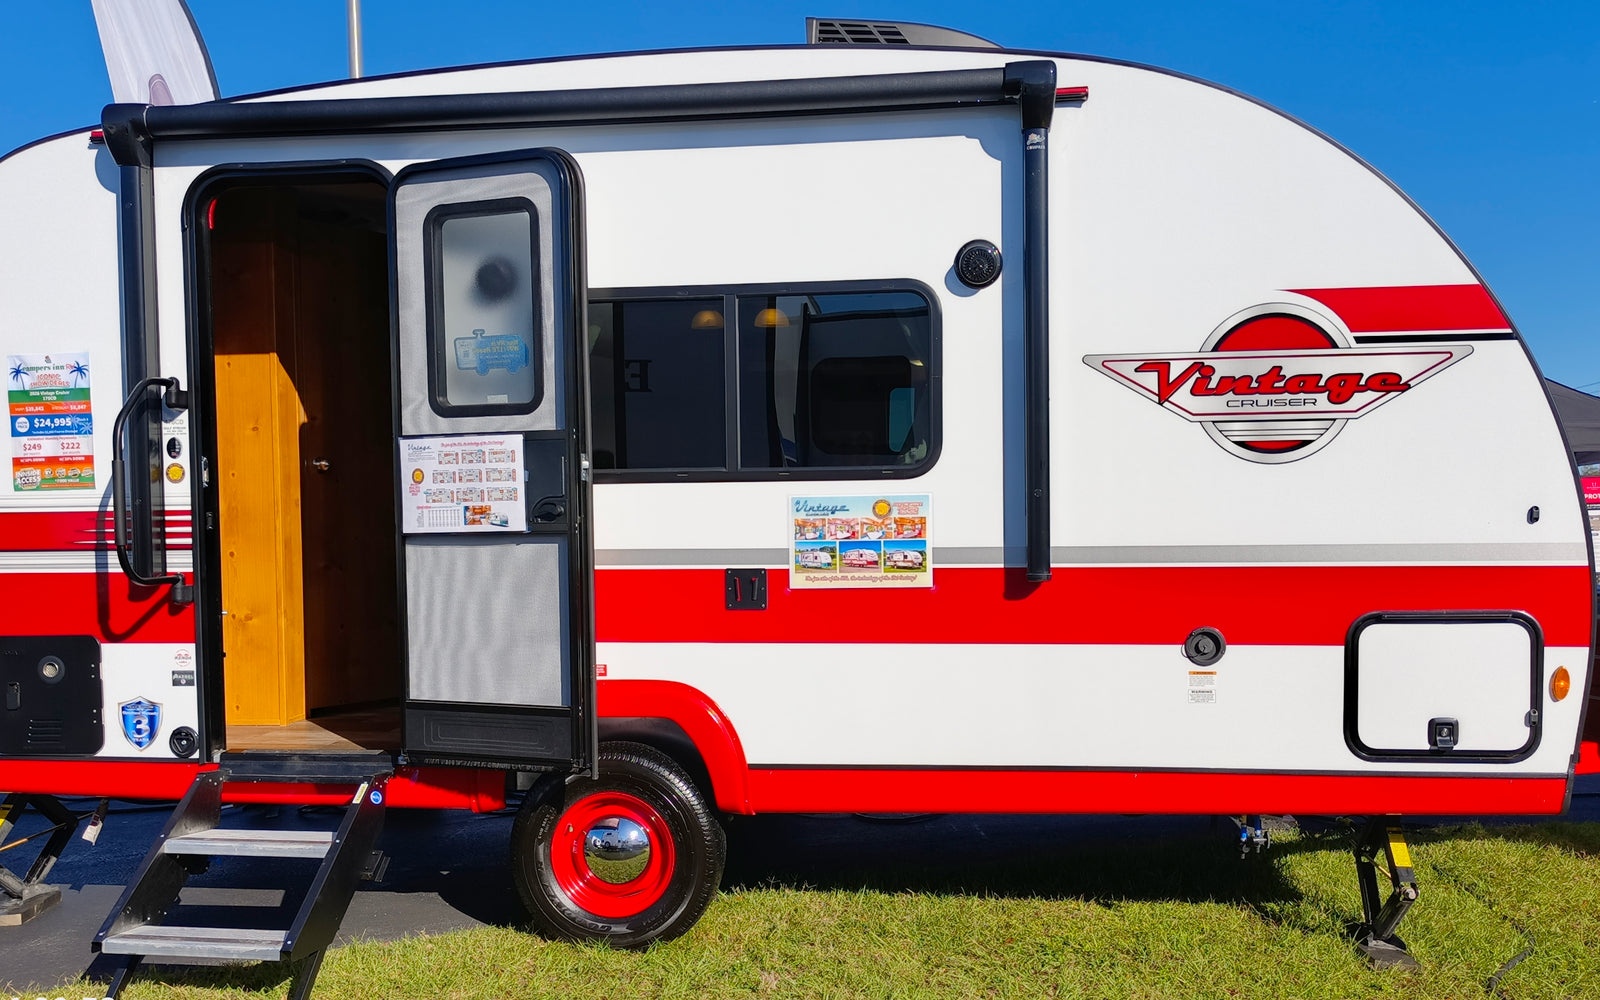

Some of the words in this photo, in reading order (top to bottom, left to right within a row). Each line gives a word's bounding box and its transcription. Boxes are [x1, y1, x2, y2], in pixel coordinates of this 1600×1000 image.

[1134, 361, 1411, 405] Vintage
[1226, 397, 1317, 408] CRUISER
[34, 417, 72, 429] $24,995
[23, 443, 42, 452] $249
[60, 441, 80, 450] $222
[795, 500, 849, 514] Vintage
[132, 716, 150, 738] 3
